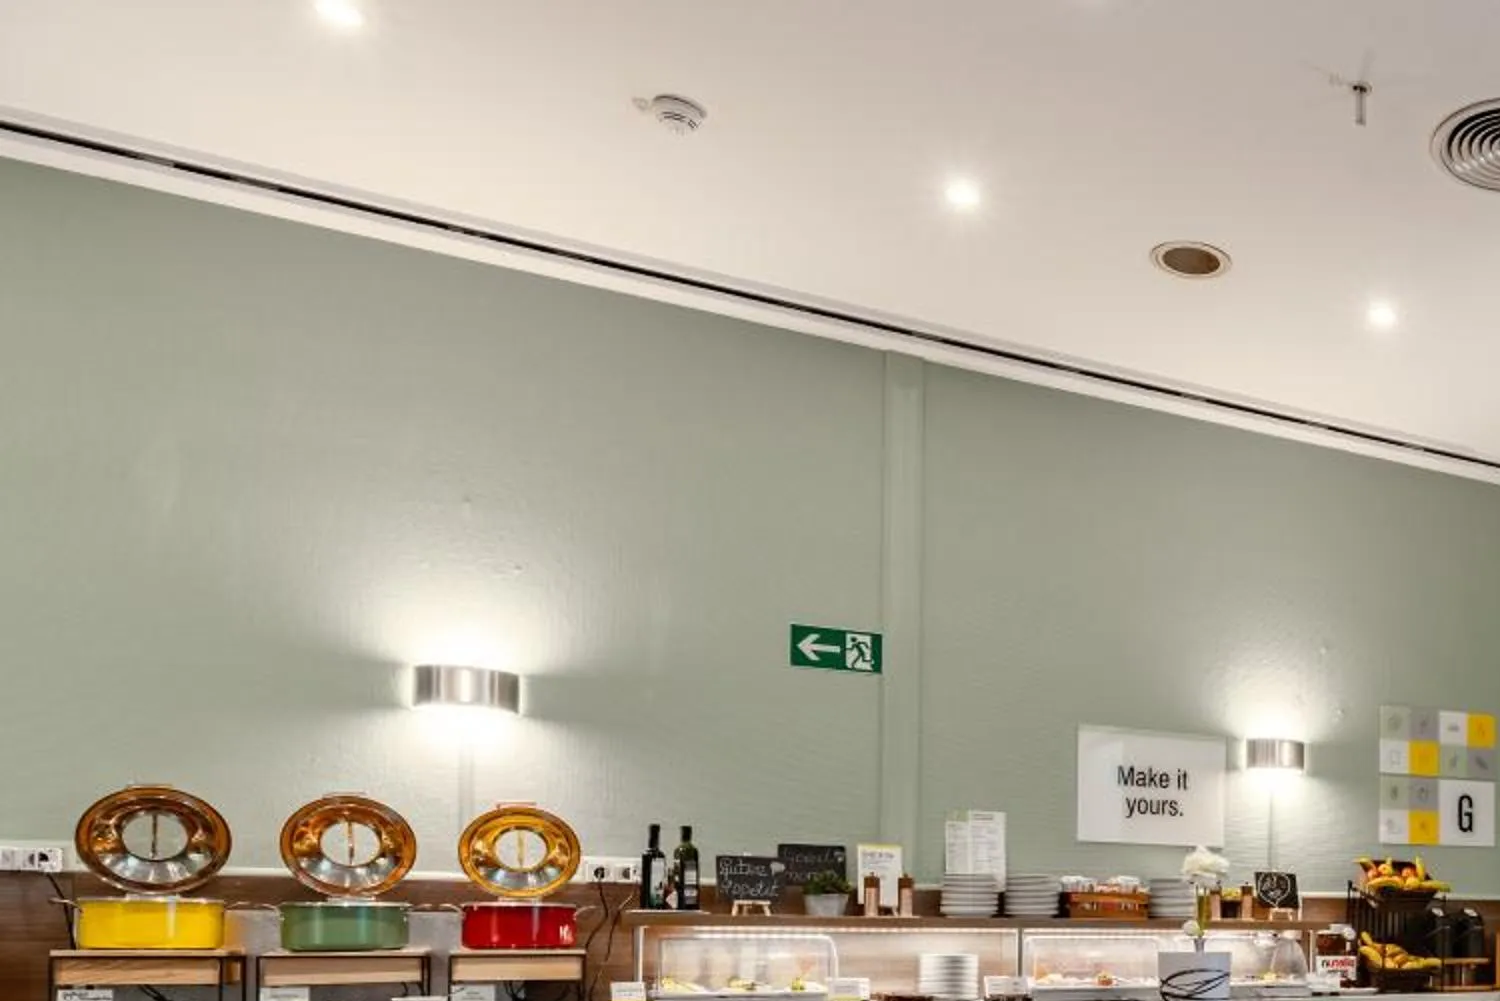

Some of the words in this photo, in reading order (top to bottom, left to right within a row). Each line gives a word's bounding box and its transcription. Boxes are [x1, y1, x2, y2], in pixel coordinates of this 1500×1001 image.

[1117, 765, 1169, 788] Make
[1177, 768, 1187, 790] it
[1125, 797, 1184, 818] yours.
[1457, 794, 1473, 832] G
